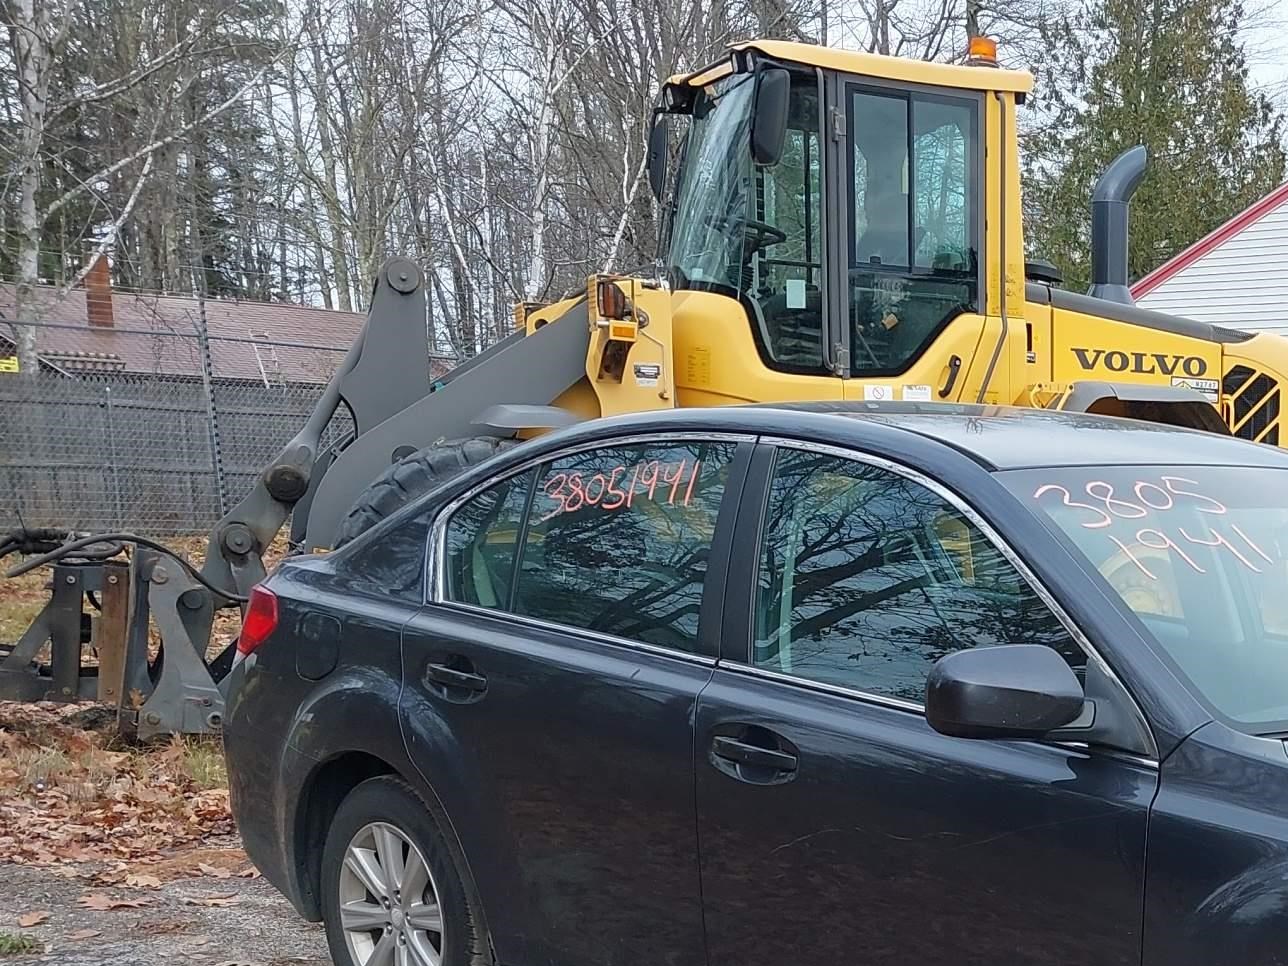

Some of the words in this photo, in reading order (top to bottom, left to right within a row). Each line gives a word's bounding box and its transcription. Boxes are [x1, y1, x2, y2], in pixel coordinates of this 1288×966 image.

[1070, 348, 1207, 377] VOLVO
[541, 458, 700, 521] 38051941
[1033, 476, 1226, 528] 3805
[1108, 523, 1273, 580] 1941
